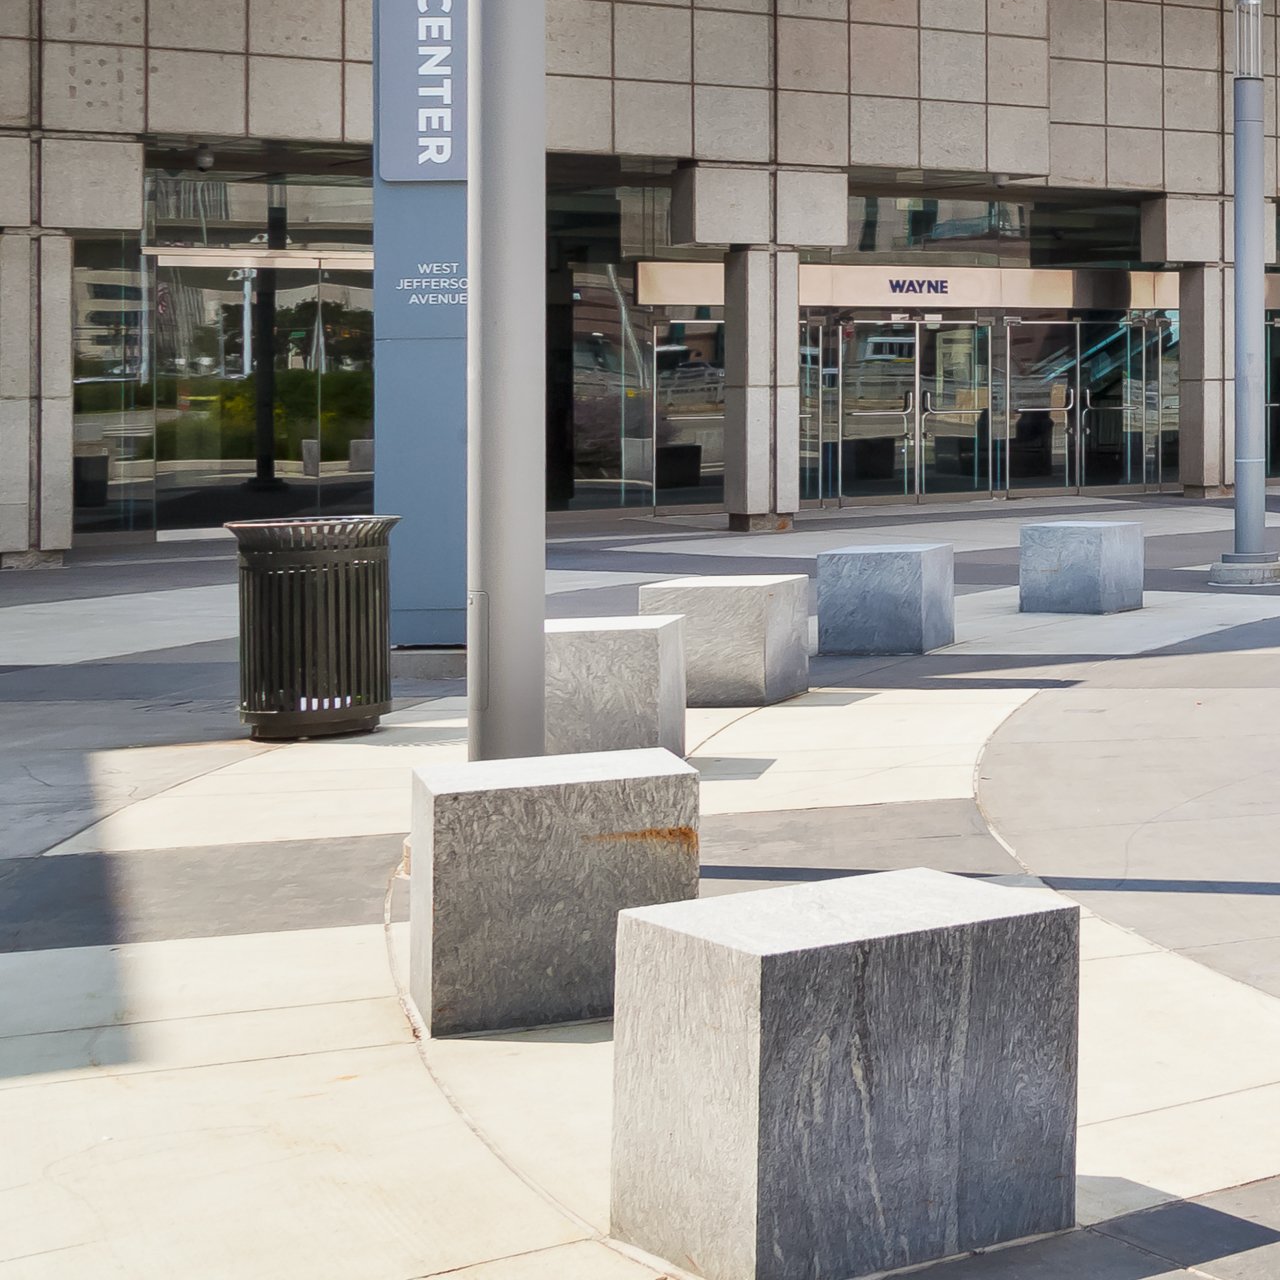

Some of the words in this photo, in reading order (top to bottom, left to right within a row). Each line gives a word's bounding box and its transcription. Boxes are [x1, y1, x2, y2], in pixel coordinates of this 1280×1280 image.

[417, 263, 459, 274] WEST
[396, 278, 469, 290] JEFFERSO
[888, 279, 948, 294] WAYNE
[408, 293, 468, 305] AVENUE
